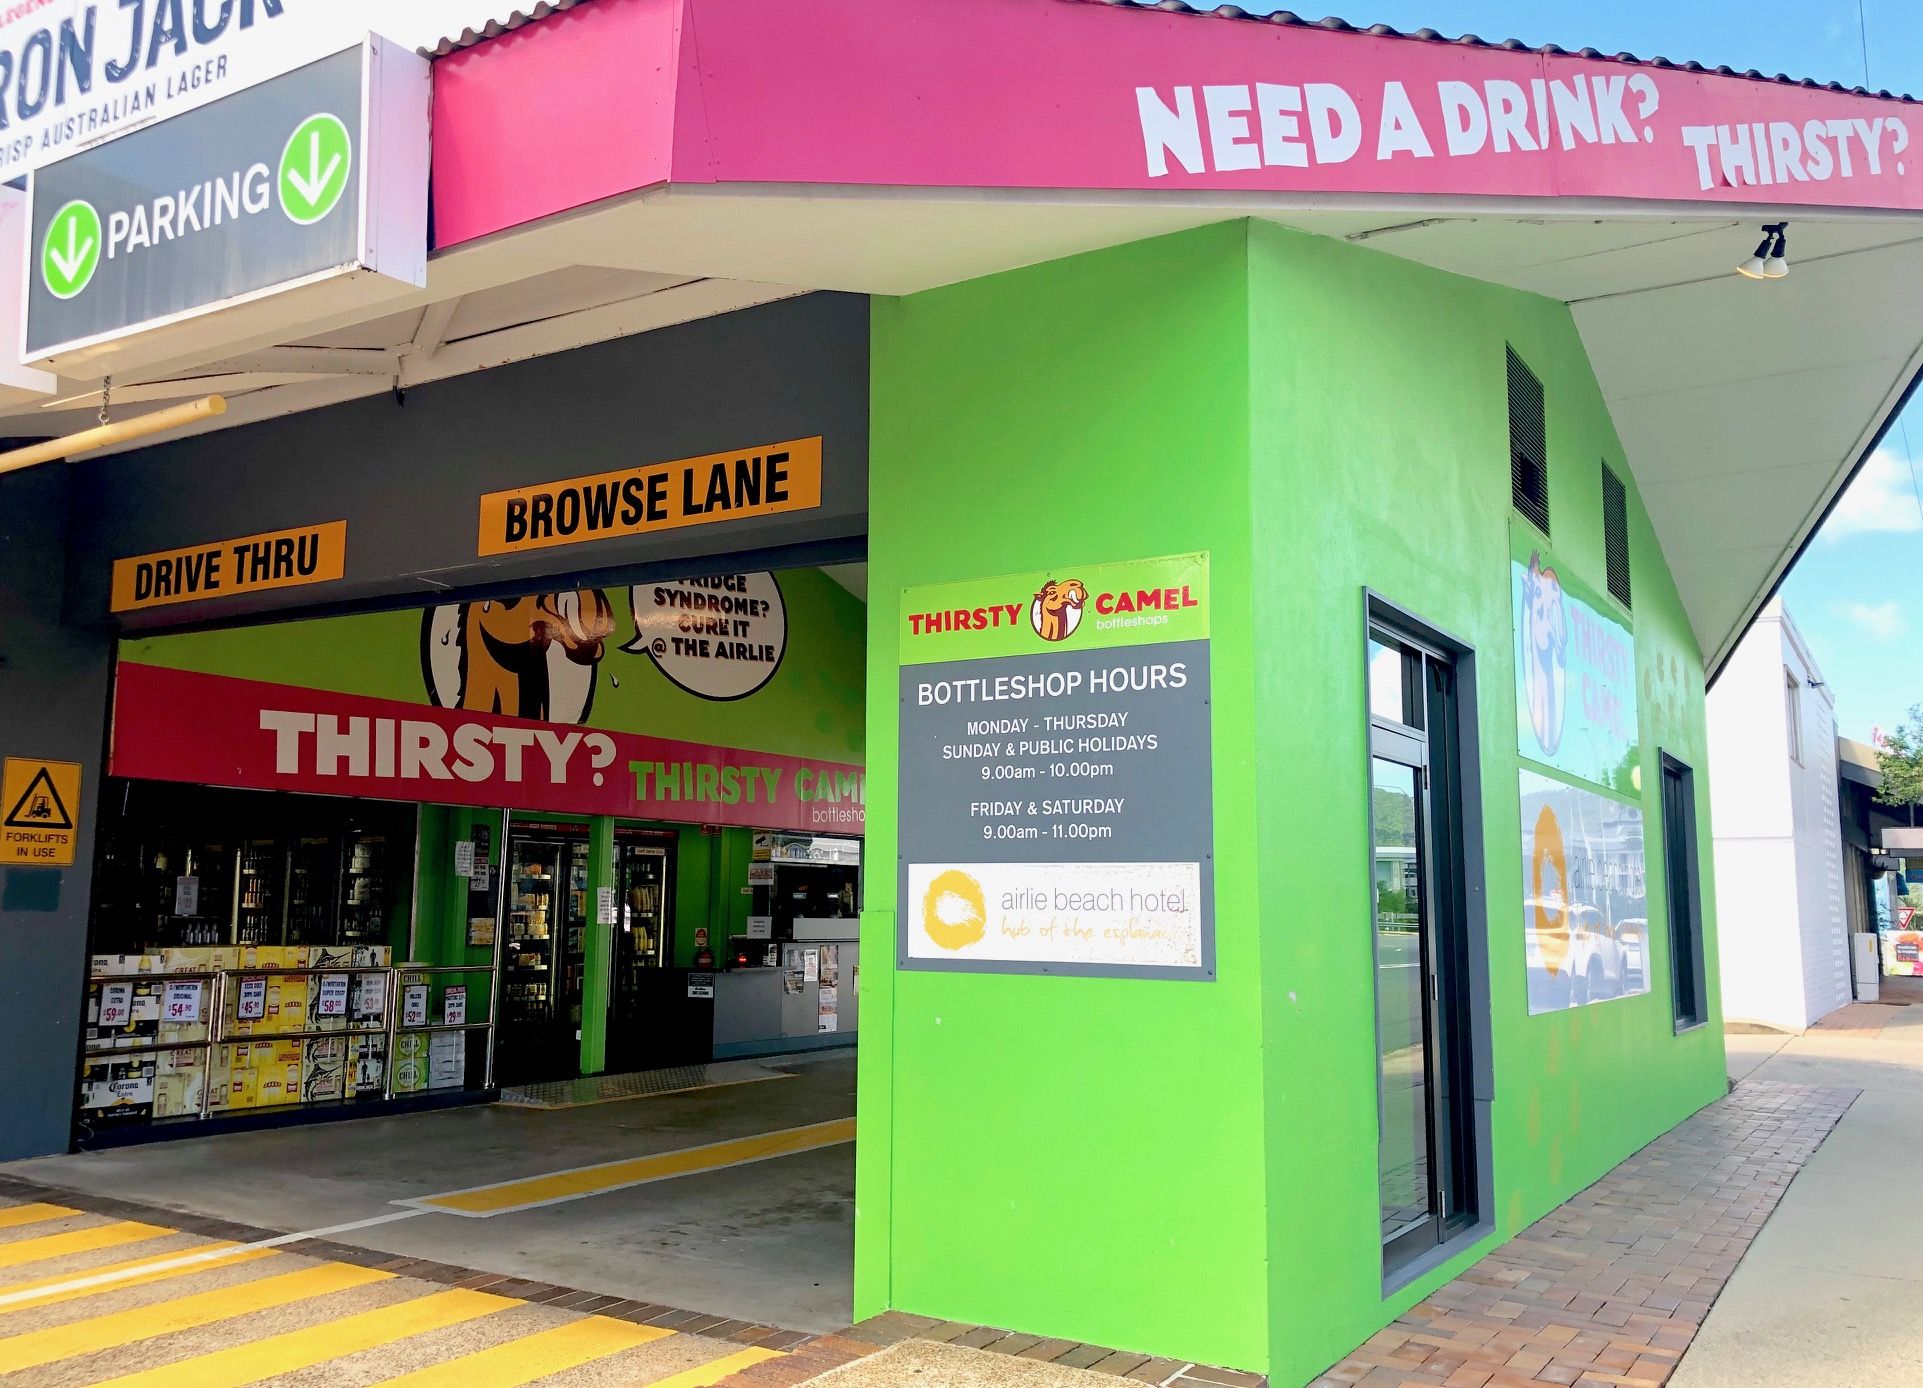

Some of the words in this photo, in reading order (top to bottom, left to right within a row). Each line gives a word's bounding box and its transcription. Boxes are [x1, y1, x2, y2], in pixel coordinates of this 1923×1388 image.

[41, 83, 157, 149] AUSTRALIAN
[167, 54, 228, 100] LAGER
[1135, 81, 1362, 178] NEED
[1376, 80, 1435, 161] A
[1437, 72, 1660, 156] DRINK?
[1681, 115, 1909, 191] THIRSTY?
[106, 163, 271, 259] PARKING
[505, 472, 669, 545] BROWSE
[682, 452, 791, 516] LANE
[135, 552, 220, 601] DRIVE
[232, 533, 319, 586] THRU
[653, 586, 771, 618] SYNDROME?
[908, 603, 1023, 636] THIRSTY
[1095, 585, 1198, 616] CAMEL
[678, 613, 730, 637] CURE
[733, 619, 750, 638] IT
[1096, 614, 1168, 631] bottleshops
[651, 637, 667, 658] @
[671, 637, 710, 658] THE
[714, 642, 776, 662] AIRLIE
[917, 671, 1083, 707] BOTTLESHOP
[1089, 662, 1188, 694] HOURS
[967, 717, 1029, 736] MONDAY
[1044, 711, 1129, 732] THURSDAY
[259, 709, 617, 787] THIRSTY?
[942, 742, 1001, 760] SUNDAY
[1005, 741, 1015, 757] &
[1019, 738, 1074, 756] PUBLIC
[1078, 733, 1159, 754] HOLIDAYS
[629, 760, 784, 805] THIRSTY
[981, 765, 1036, 780] 9.00am
[1049, 762, 1114, 779] 10.00pm
[970, 801, 1022, 817] FRIDAY
[1027, 800, 1038, 816] &
[1042, 798, 1125, 816] SATURDAY
[6, 832, 69, 845] FORKLIFTS
[983, 825, 1038, 840] 9.00am
[1051, 823, 1112, 840] 11.00pm
[16, 846, 28, 857] IN
[33, 847, 56, 858] USE
[1001, 887, 1047, 911] airlie
[1054, 887, 1124, 911] beach
[1130, 887, 1185, 912] hotel
[1001, 916, 1031, 940] hub
[1039, 917, 1057, 943] of
[1063, 917, 1095, 942] the
[168, 1003, 192, 1016] $54.90
